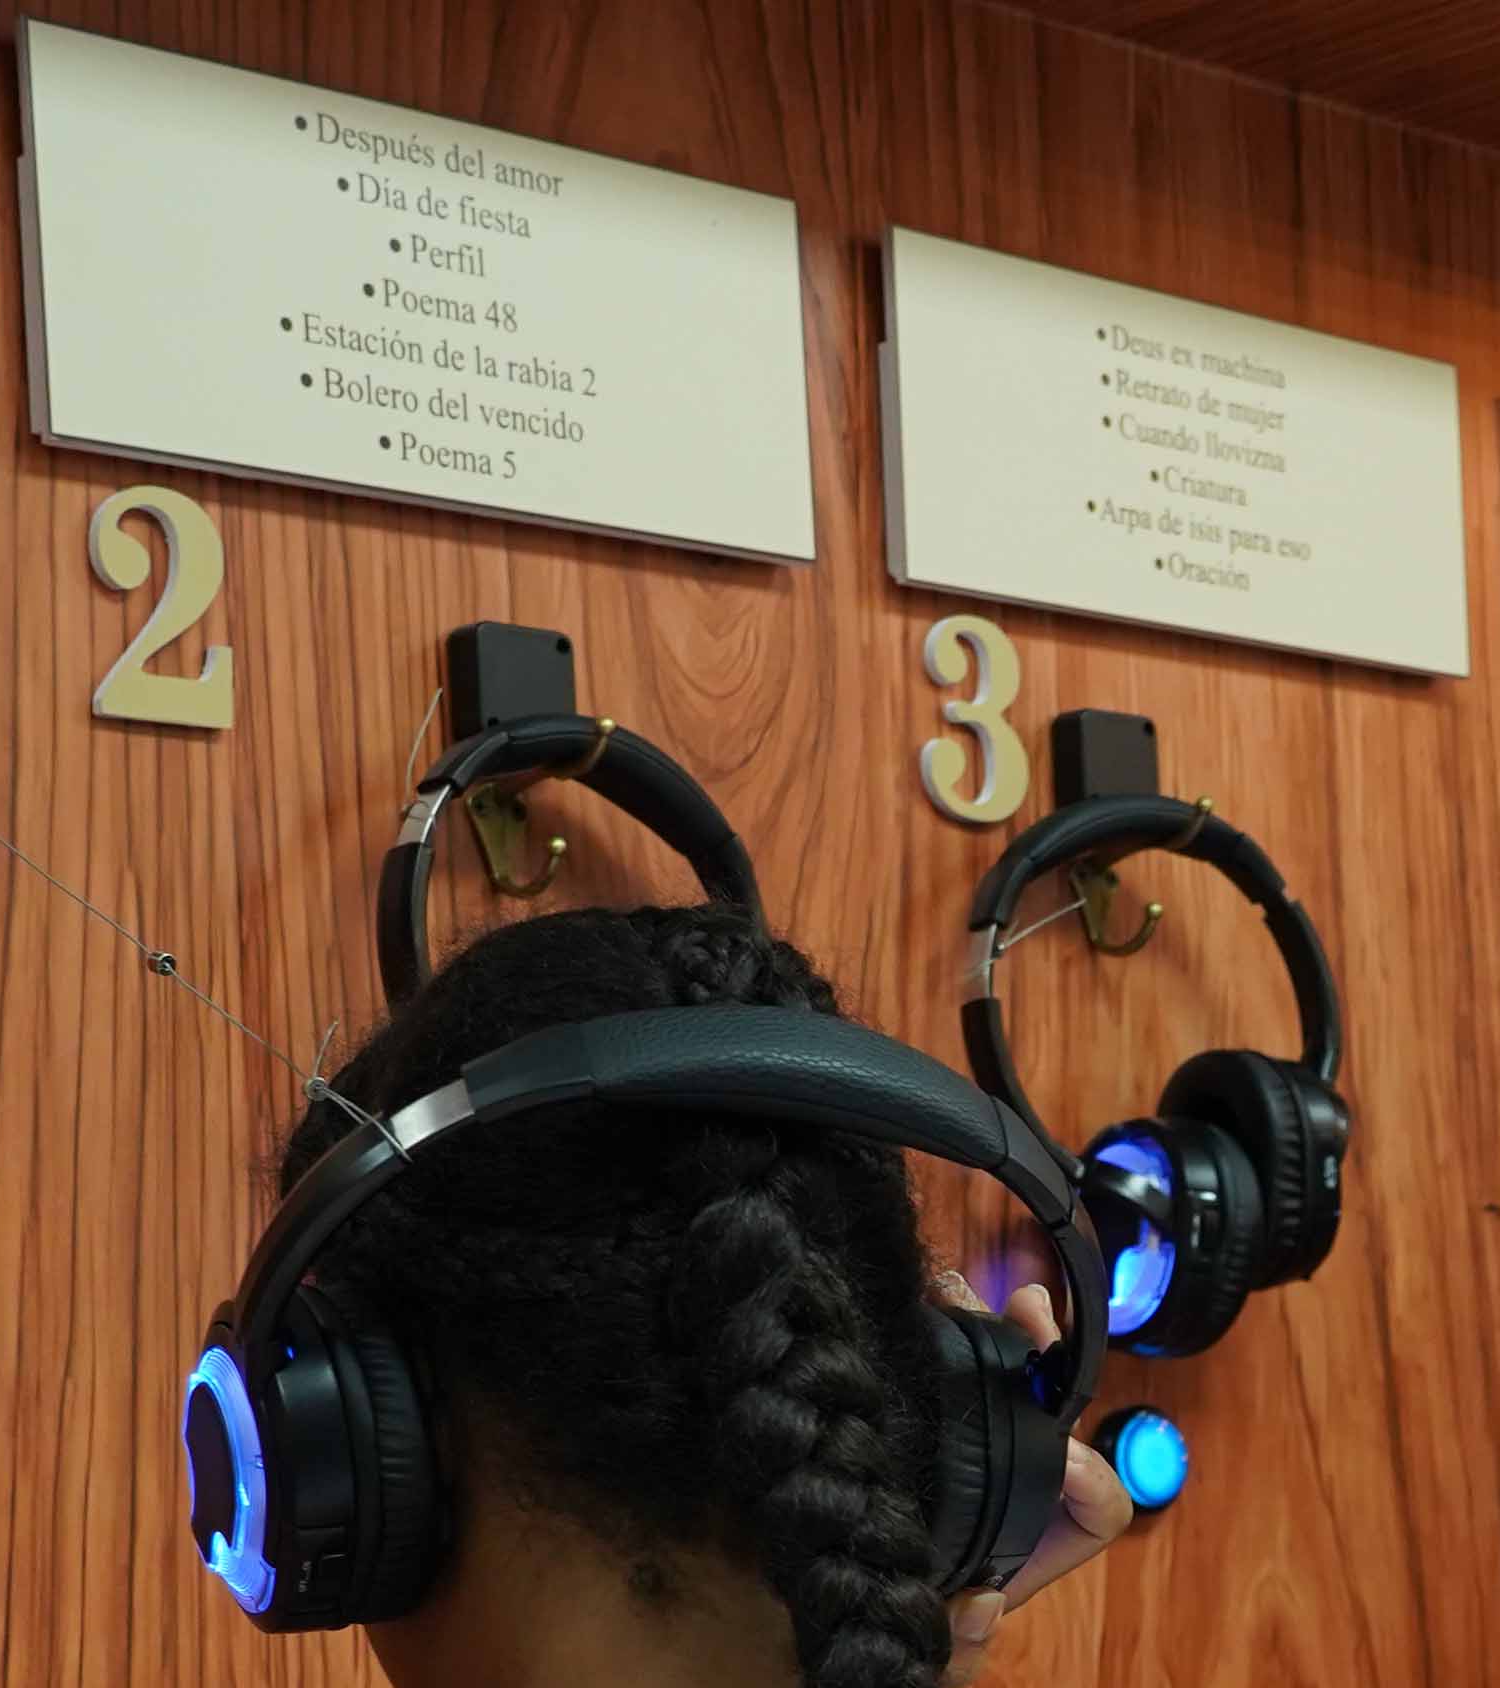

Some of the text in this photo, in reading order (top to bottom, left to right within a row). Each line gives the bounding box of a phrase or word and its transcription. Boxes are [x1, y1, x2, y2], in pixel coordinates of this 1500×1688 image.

[316, 111, 564, 197] Después del amor
[357, 171, 531, 239] Día de fiesta
[410, 233, 485, 278] Perfil
[381, 277, 518, 333] Poema 48
[301, 311, 597, 398] Estación de la rabia 2
[1110, 323, 1286, 390] Deus ex machina
[323, 366, 584, 443] Bolero del vencido
[1115, 367, 1285, 434] Retrato de mujer
[399, 430, 517, 480] Poema 5
[1117, 412, 1286, 473] Cuando llovizna
[1162, 465, 1248, 507] Criatura
[1099, 496, 1152, 535] Arpa
[1157, 507, 1183, 536] de
[1228, 528, 1272, 555] para
[1167, 551, 1250, 592] Oración
[88, 484, 234, 729] 2
[919, 613, 1031, 823] 3
